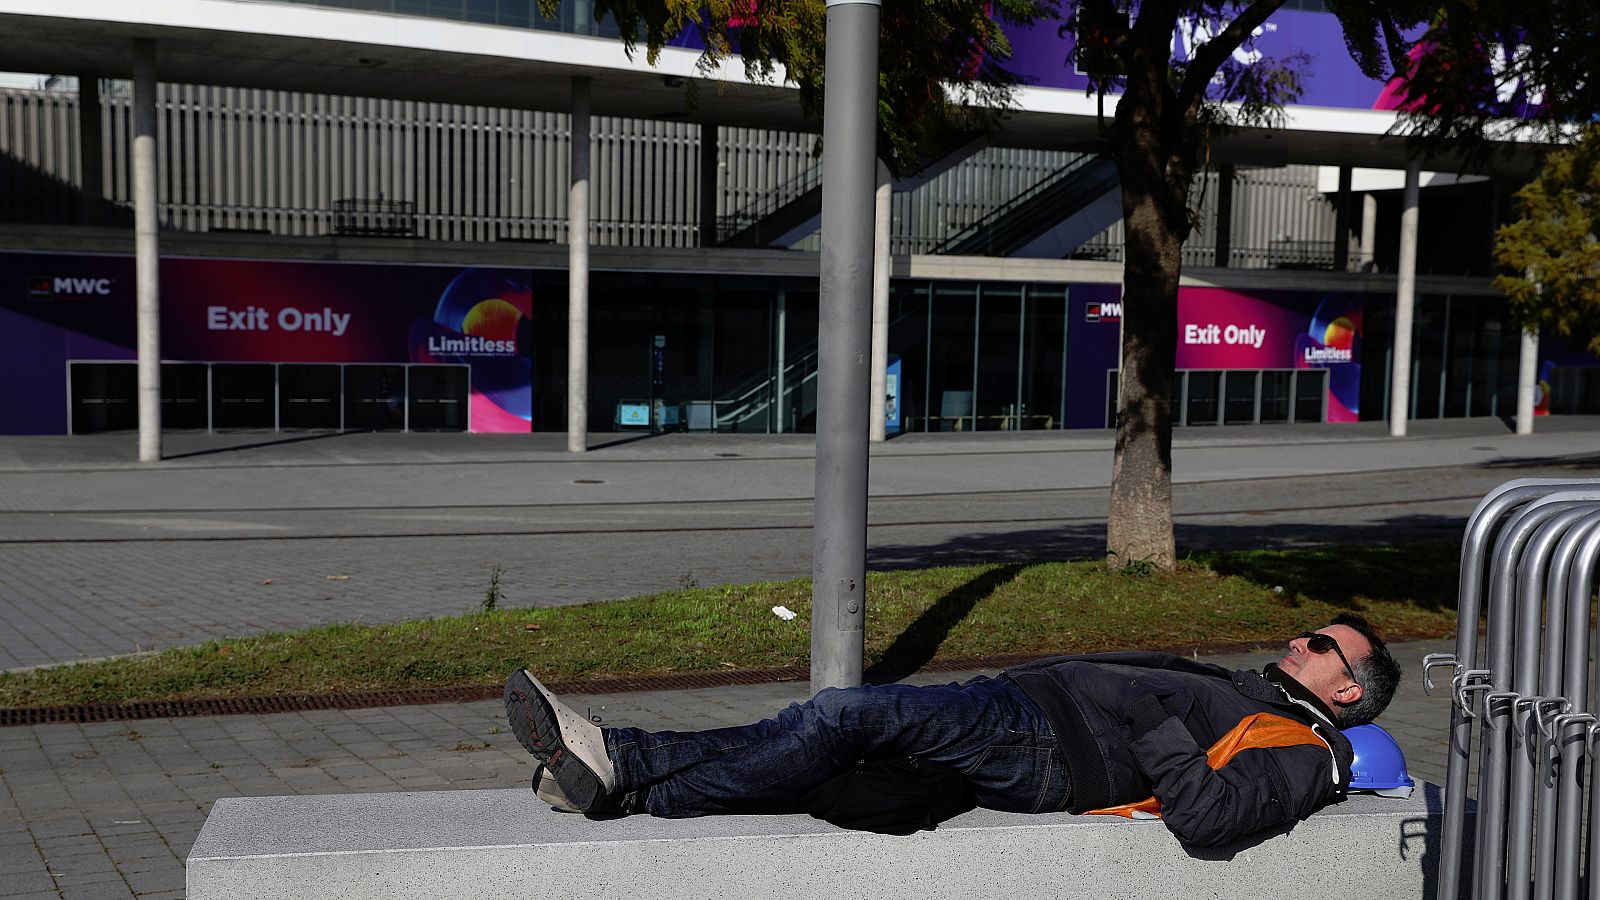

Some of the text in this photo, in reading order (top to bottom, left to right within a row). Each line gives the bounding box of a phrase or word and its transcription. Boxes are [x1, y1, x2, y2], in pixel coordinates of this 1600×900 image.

[54, 277, 110, 295] MWC
[1100, 302, 1122, 317] MW
[207, 305, 351, 337] Exit Only
[428, 336, 515, 353] Limitless
[1184, 323, 1266, 349] Exit Only
[1304, 346, 1352, 360] Limitless
